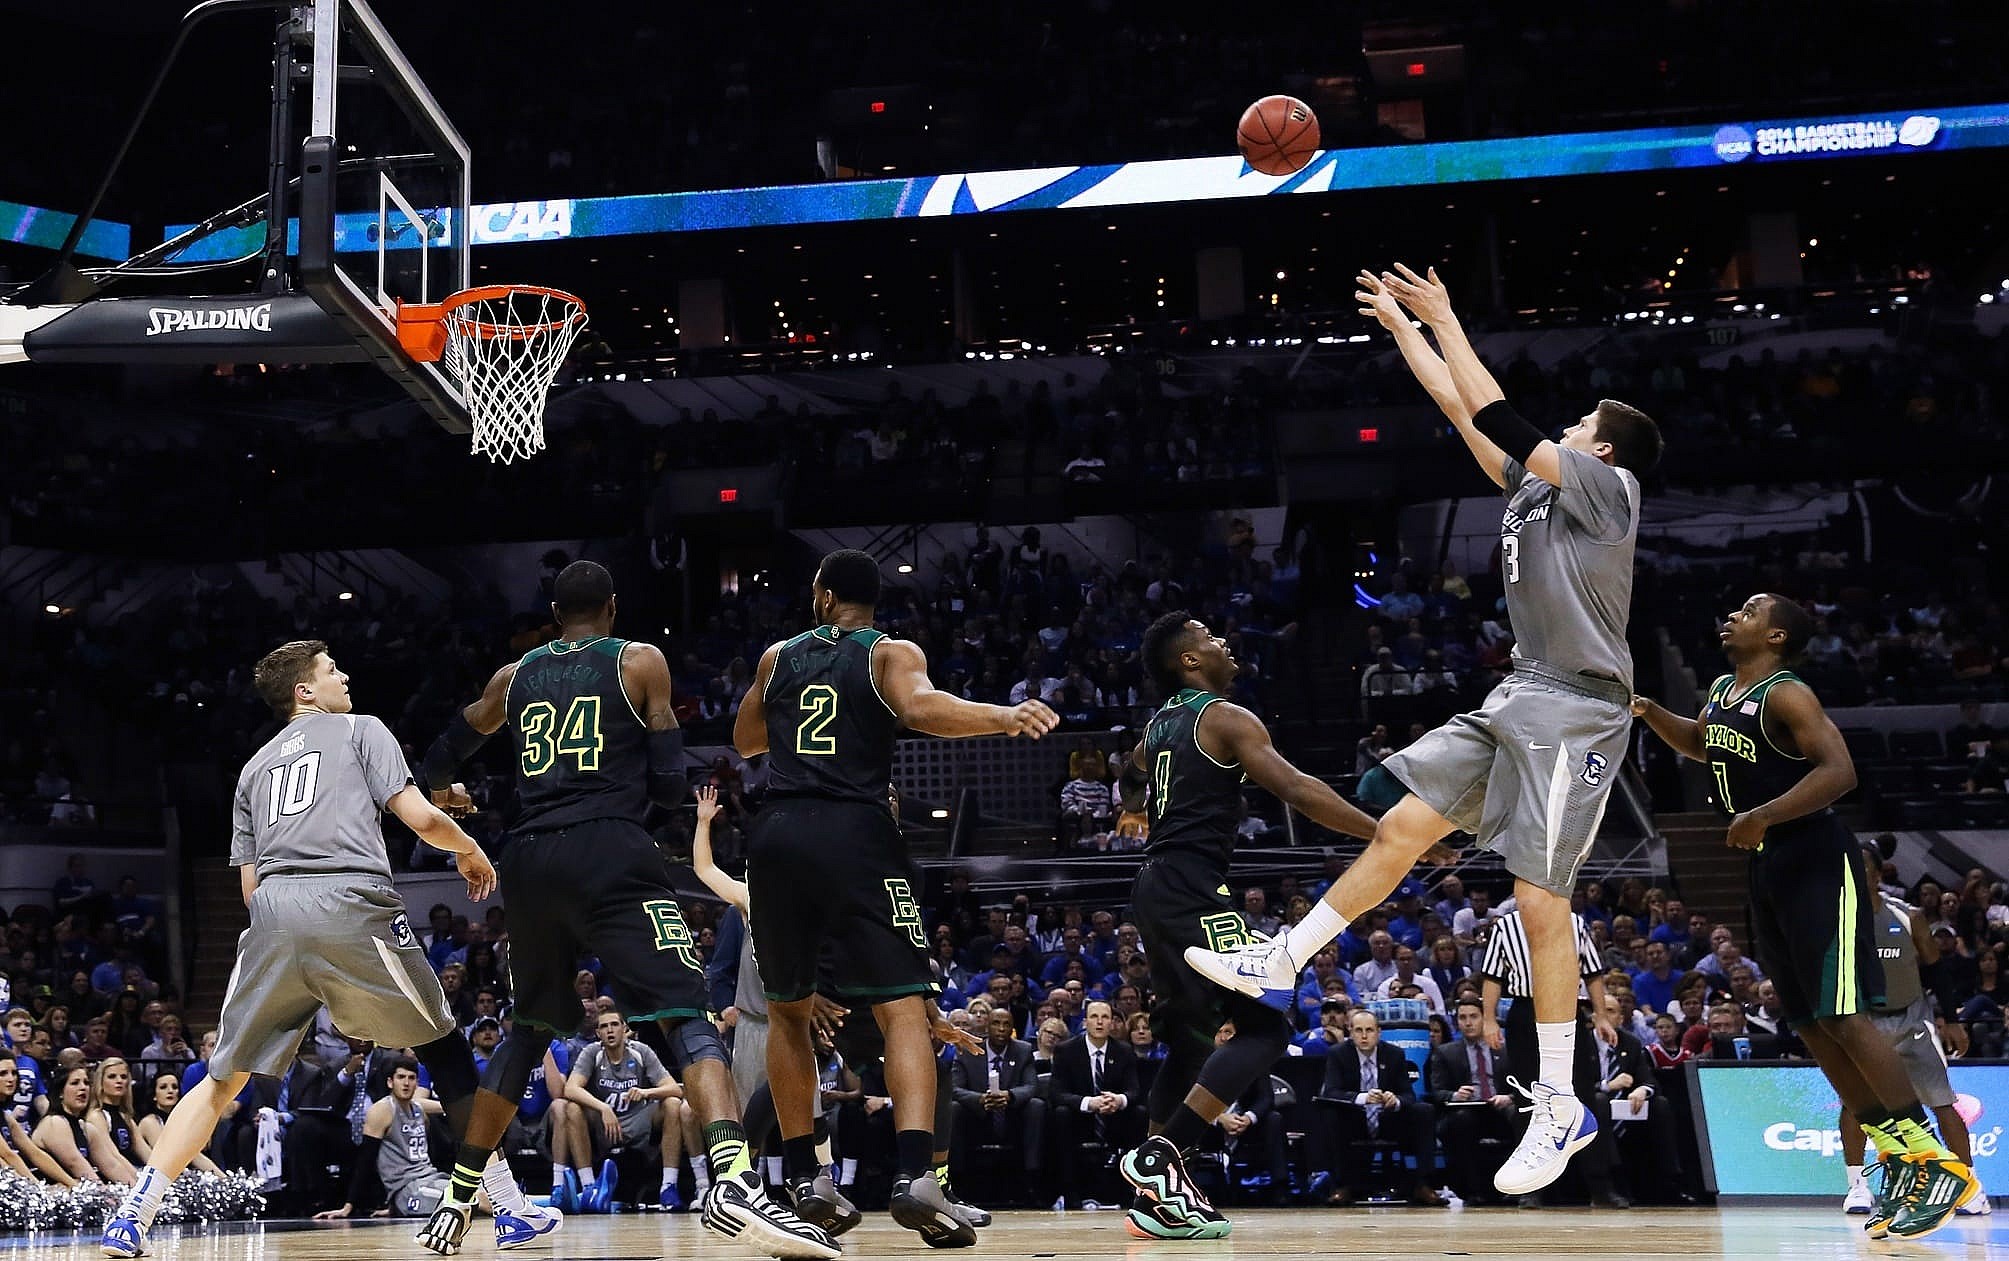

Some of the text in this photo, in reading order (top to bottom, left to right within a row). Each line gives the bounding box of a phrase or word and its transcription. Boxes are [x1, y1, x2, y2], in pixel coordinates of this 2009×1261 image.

[1757, 132, 1897, 155] CHAMPIONSHIP
[1795, 119, 1896, 139] BASKETBALL
[146, 303, 272, 336] SPALDING
[796, 684, 839, 754] 2
[280, 733, 306, 758] GIBBS
[520, 696, 604, 777] 34
[267, 750, 321, 828] 10
[408, 1137, 428, 1161] 22
